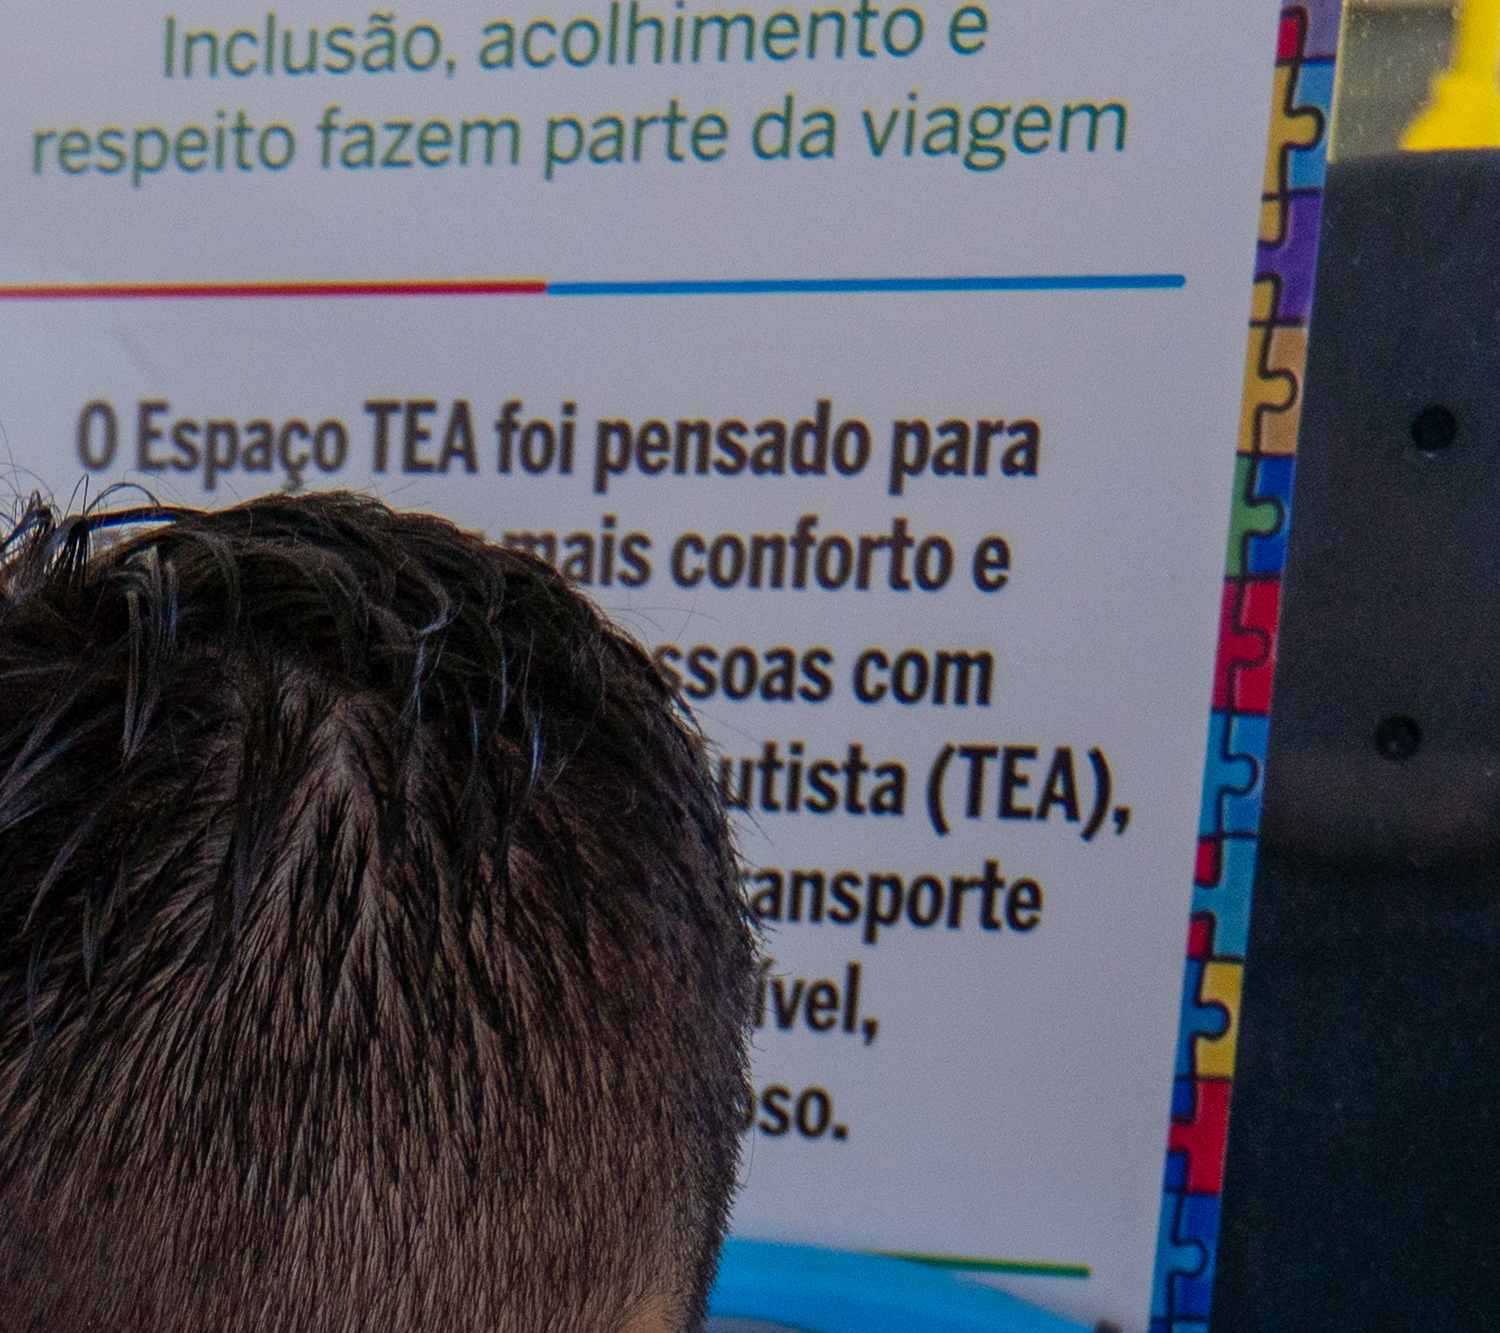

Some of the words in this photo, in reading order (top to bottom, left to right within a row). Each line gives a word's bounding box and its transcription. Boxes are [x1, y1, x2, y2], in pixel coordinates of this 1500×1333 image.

[163, 10, 457, 78] Inclusão,
[479, 0, 926, 72] acolhimento
[948, 3, 989, 56] e
[32, 107, 297, 189] respeito
[316, 102, 521, 170] fazem
[544, 97, 730, 181] parte
[751, 91, 837, 160] da
[861, 87, 1130, 172] viagem
[76, 398, 119, 471] O
[134, 398, 350, 492] Espaço
[363, 399, 479, 475] TEA
[494, 399, 577, 475] foi
[592, 398, 873, 495] pensado
[888, 416, 1043, 496] para
[670, 513, 955, 592] conforto
[972, 532, 1014, 593] e
[654, 643, 835, 701] ssoas
[852, 646, 996, 706] com
[717, 739, 909, 816] utista
[925, 742, 1133, 843] (TEA),
[742, 857, 1045, 944] ansporte
[754, 955, 880, 1046] ível,
